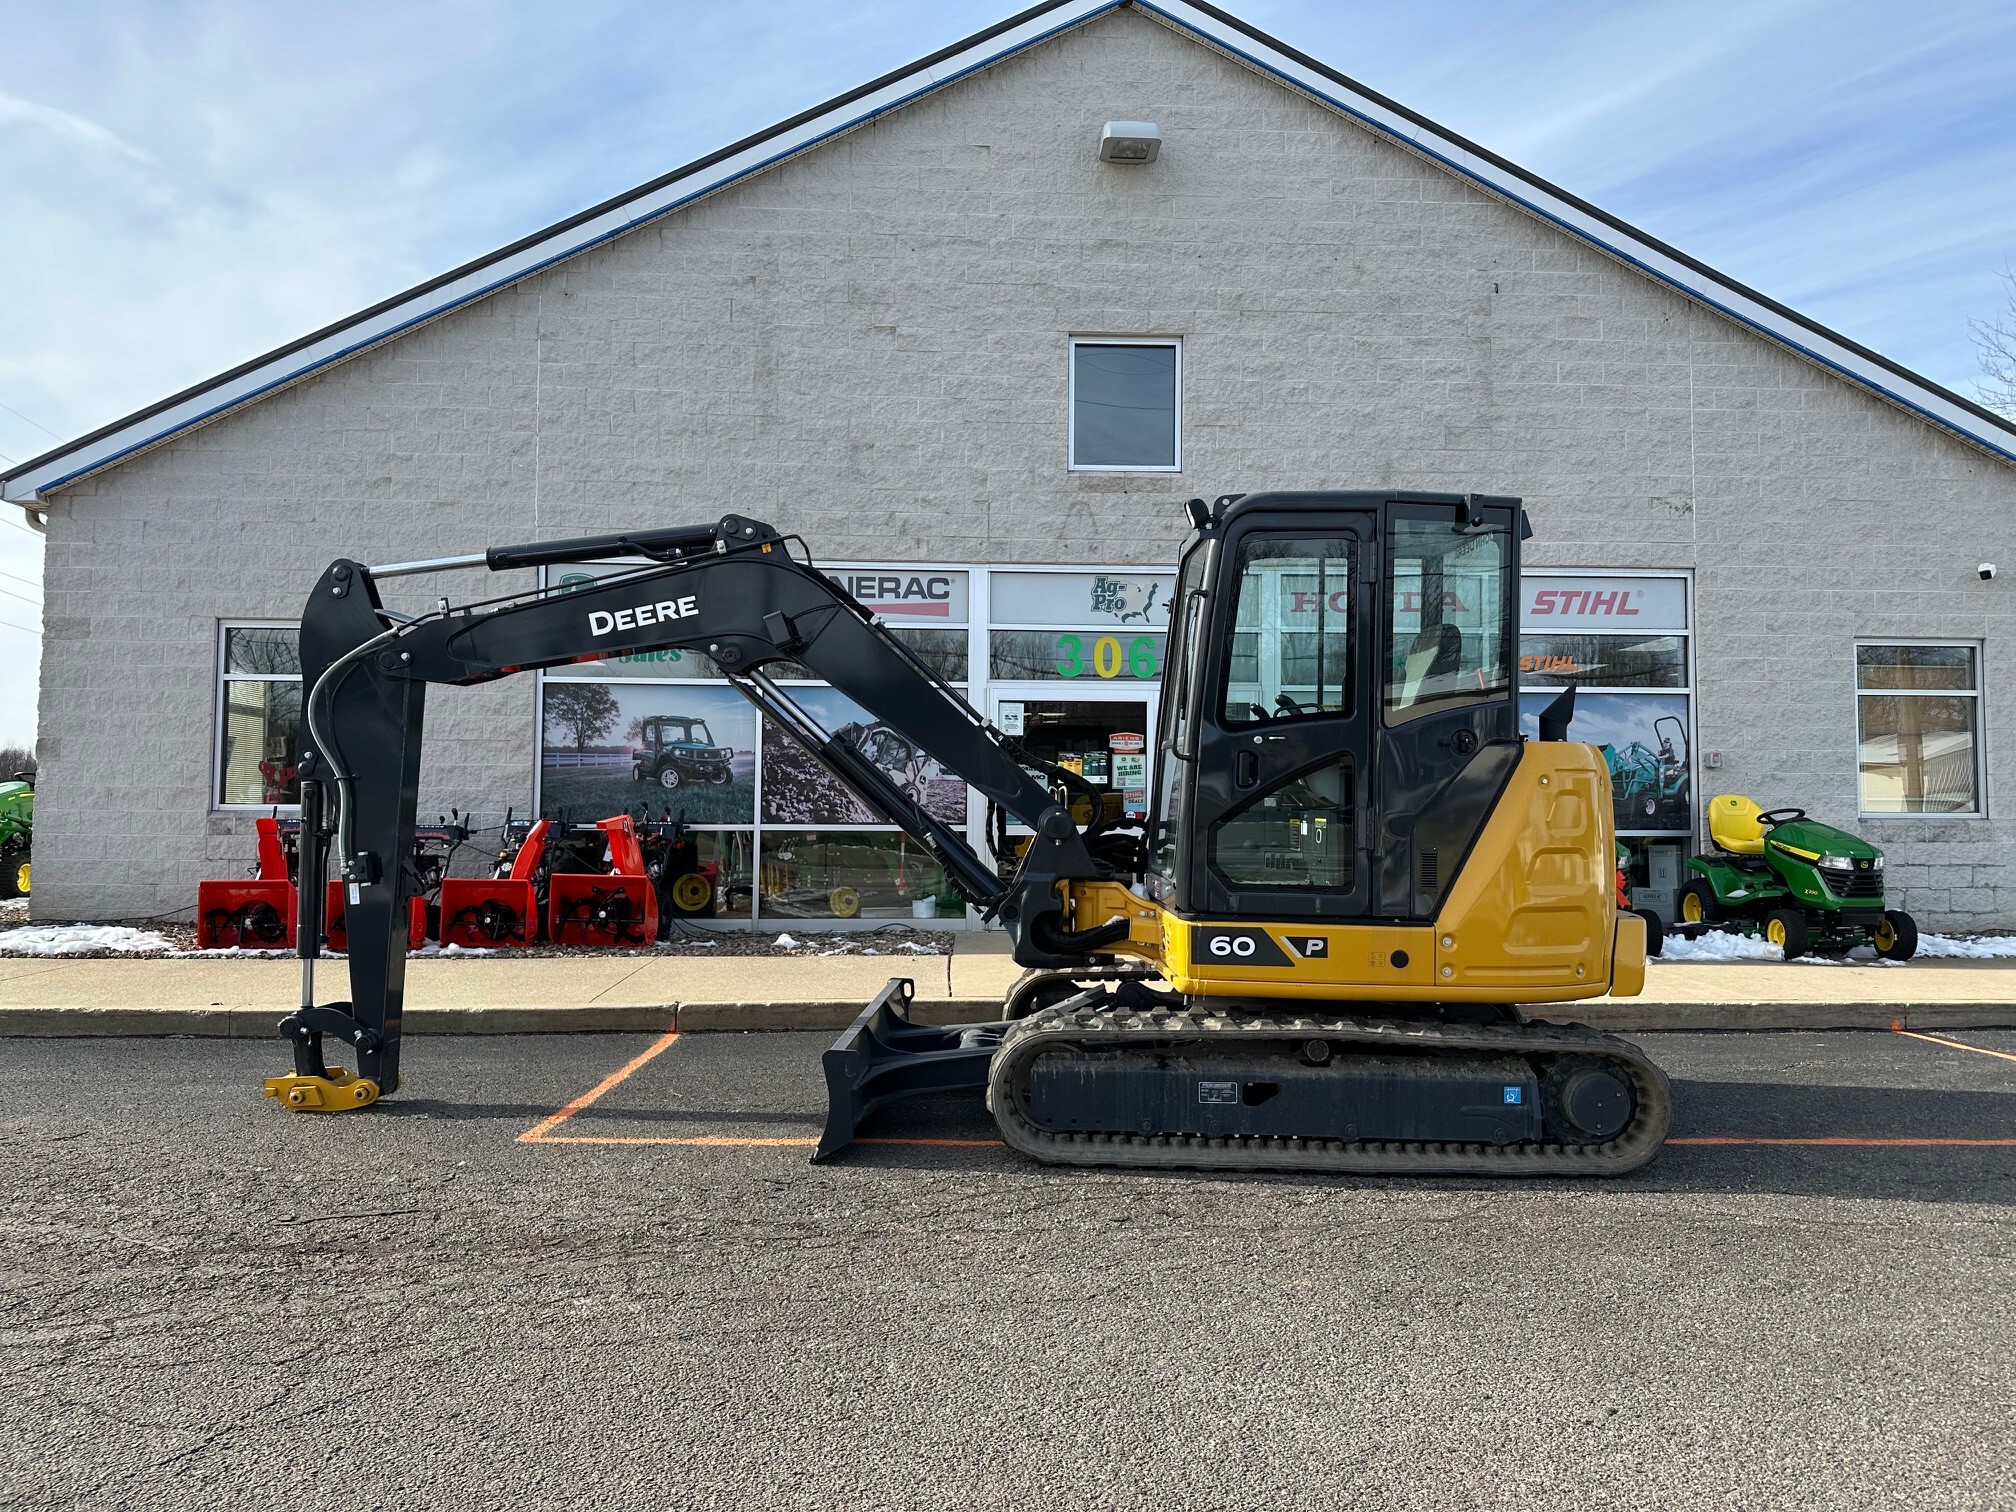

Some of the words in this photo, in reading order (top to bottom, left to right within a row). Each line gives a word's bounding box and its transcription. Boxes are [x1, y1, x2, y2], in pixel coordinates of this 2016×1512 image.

[829, 576, 950, 599] NERAC
[1092, 577, 1127, 598] Ag-
[1092, 594, 1126, 611] Pro
[1530, 590, 1640, 615] STIHL
[588, 595, 699, 637] DEERE
[1519, 656, 1579, 671] STIHL
[1209, 936, 1257, 956] 60
[1305, 939, 1324, 956] P
